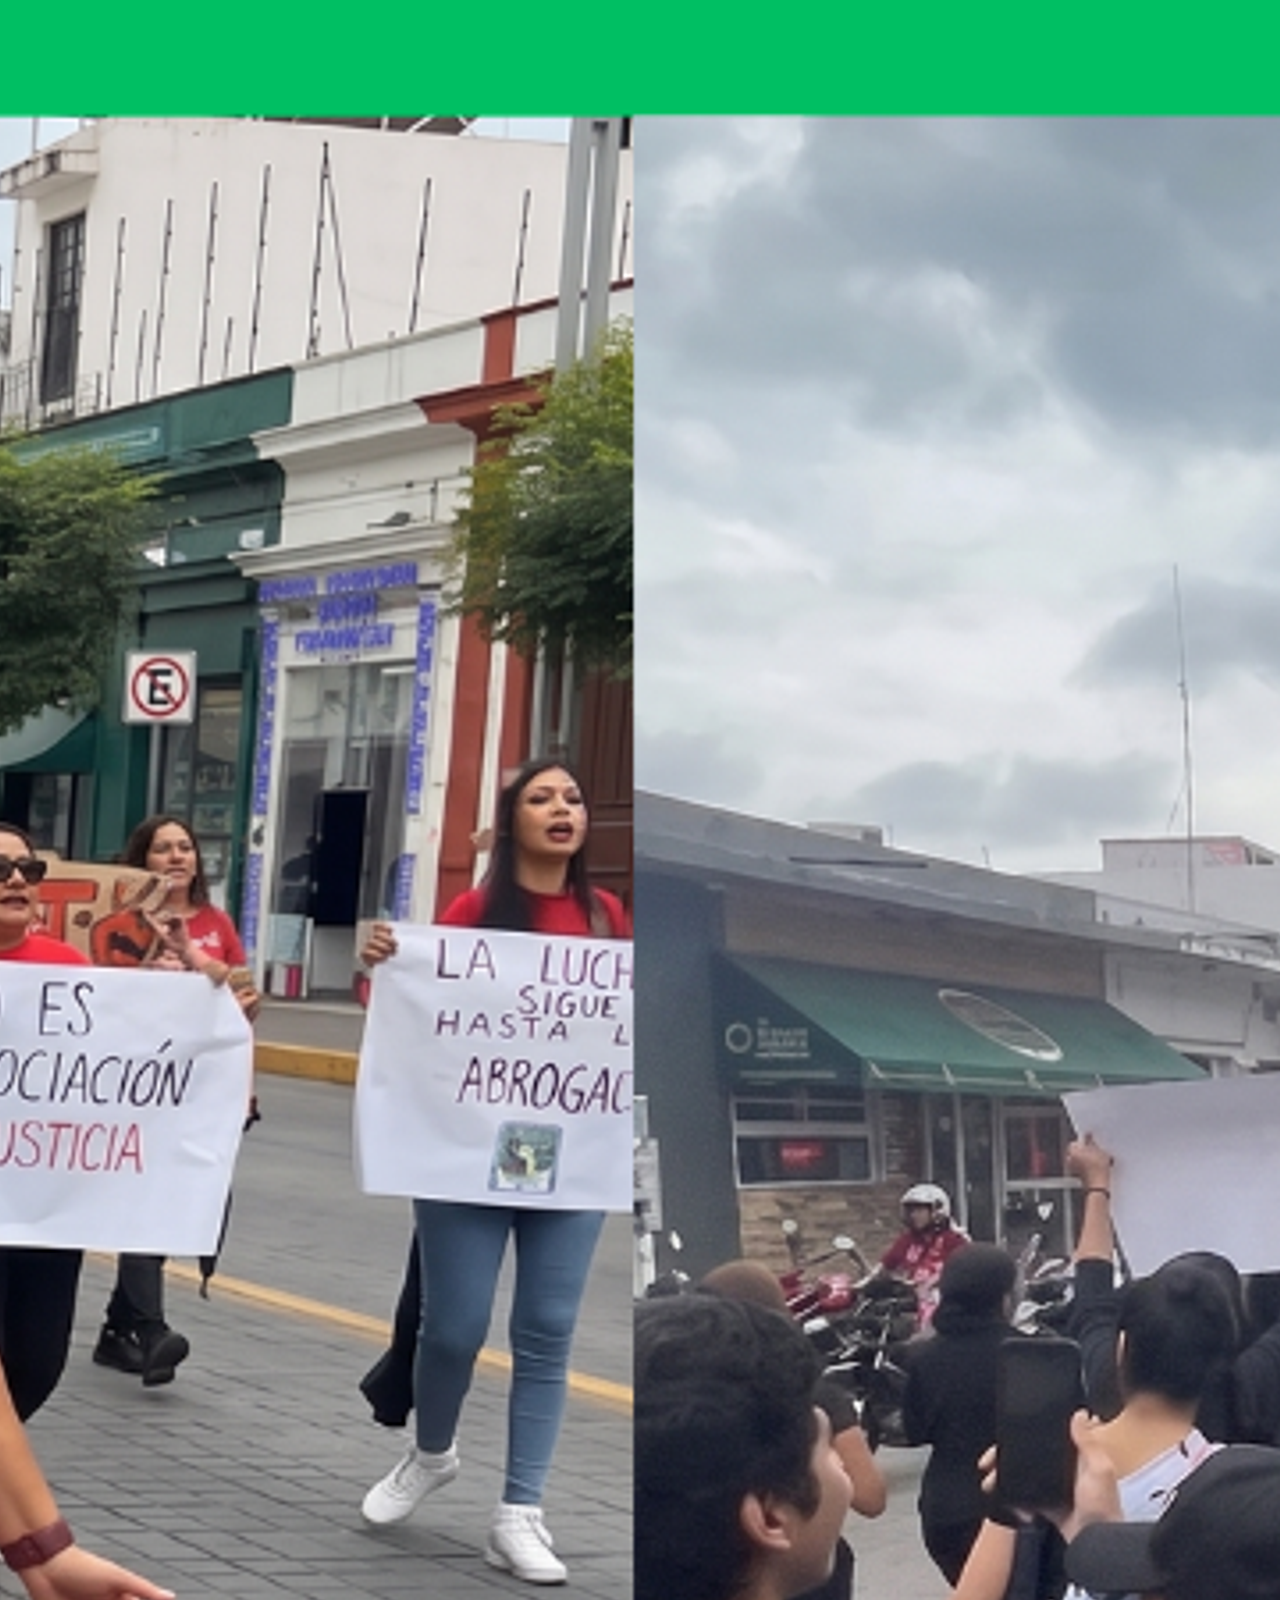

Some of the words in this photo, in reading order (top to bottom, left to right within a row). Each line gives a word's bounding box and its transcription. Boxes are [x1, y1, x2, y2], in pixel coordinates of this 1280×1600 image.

[435, 938, 496, 980] LA
[38, 981, 94, 1036] ES
[516, 984, 621, 1019] SIGUE
[434, 1009, 568, 1041] HASTA
